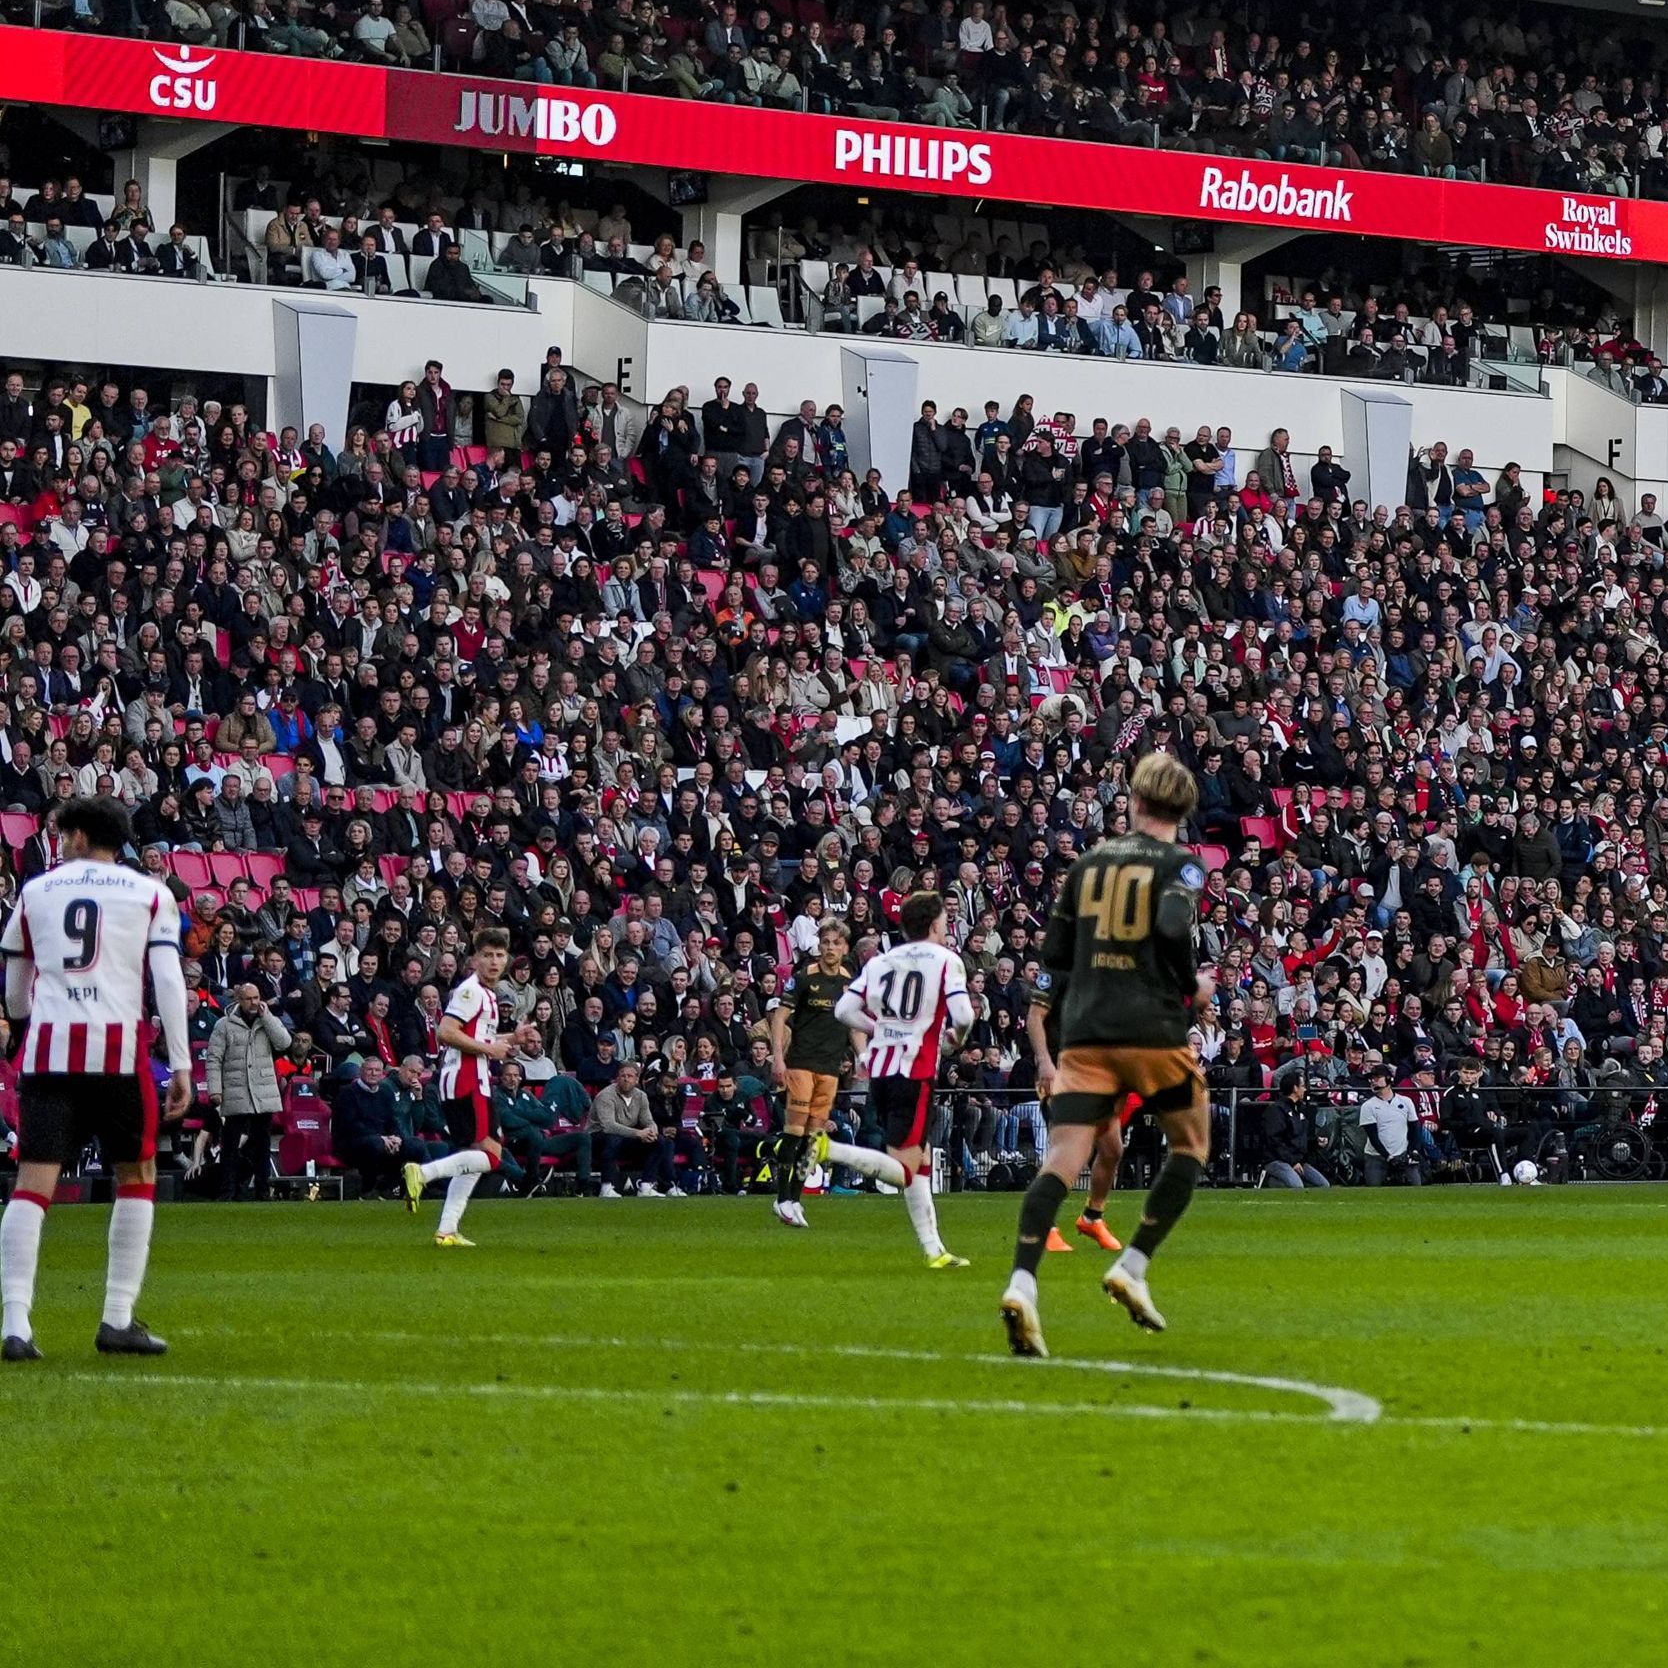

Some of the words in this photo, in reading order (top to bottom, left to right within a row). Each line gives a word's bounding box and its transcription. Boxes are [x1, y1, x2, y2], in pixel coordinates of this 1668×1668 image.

[149, 73, 217, 111] CSU
[455, 90, 617, 147] JUMBO
[834, 129, 993, 185] PHILIPS
[1199, 166, 1353, 223] Rabobank
[1561, 196, 1618, 230] Royal
[1545, 221, 1632, 257] Swinkels
[617, 357, 633, 393] E
[1608, 438, 1624, 468] F
[1078, 863, 1155, 943] 40
[63, 898, 102, 973] 9
[880, 969, 925, 1022] 10
